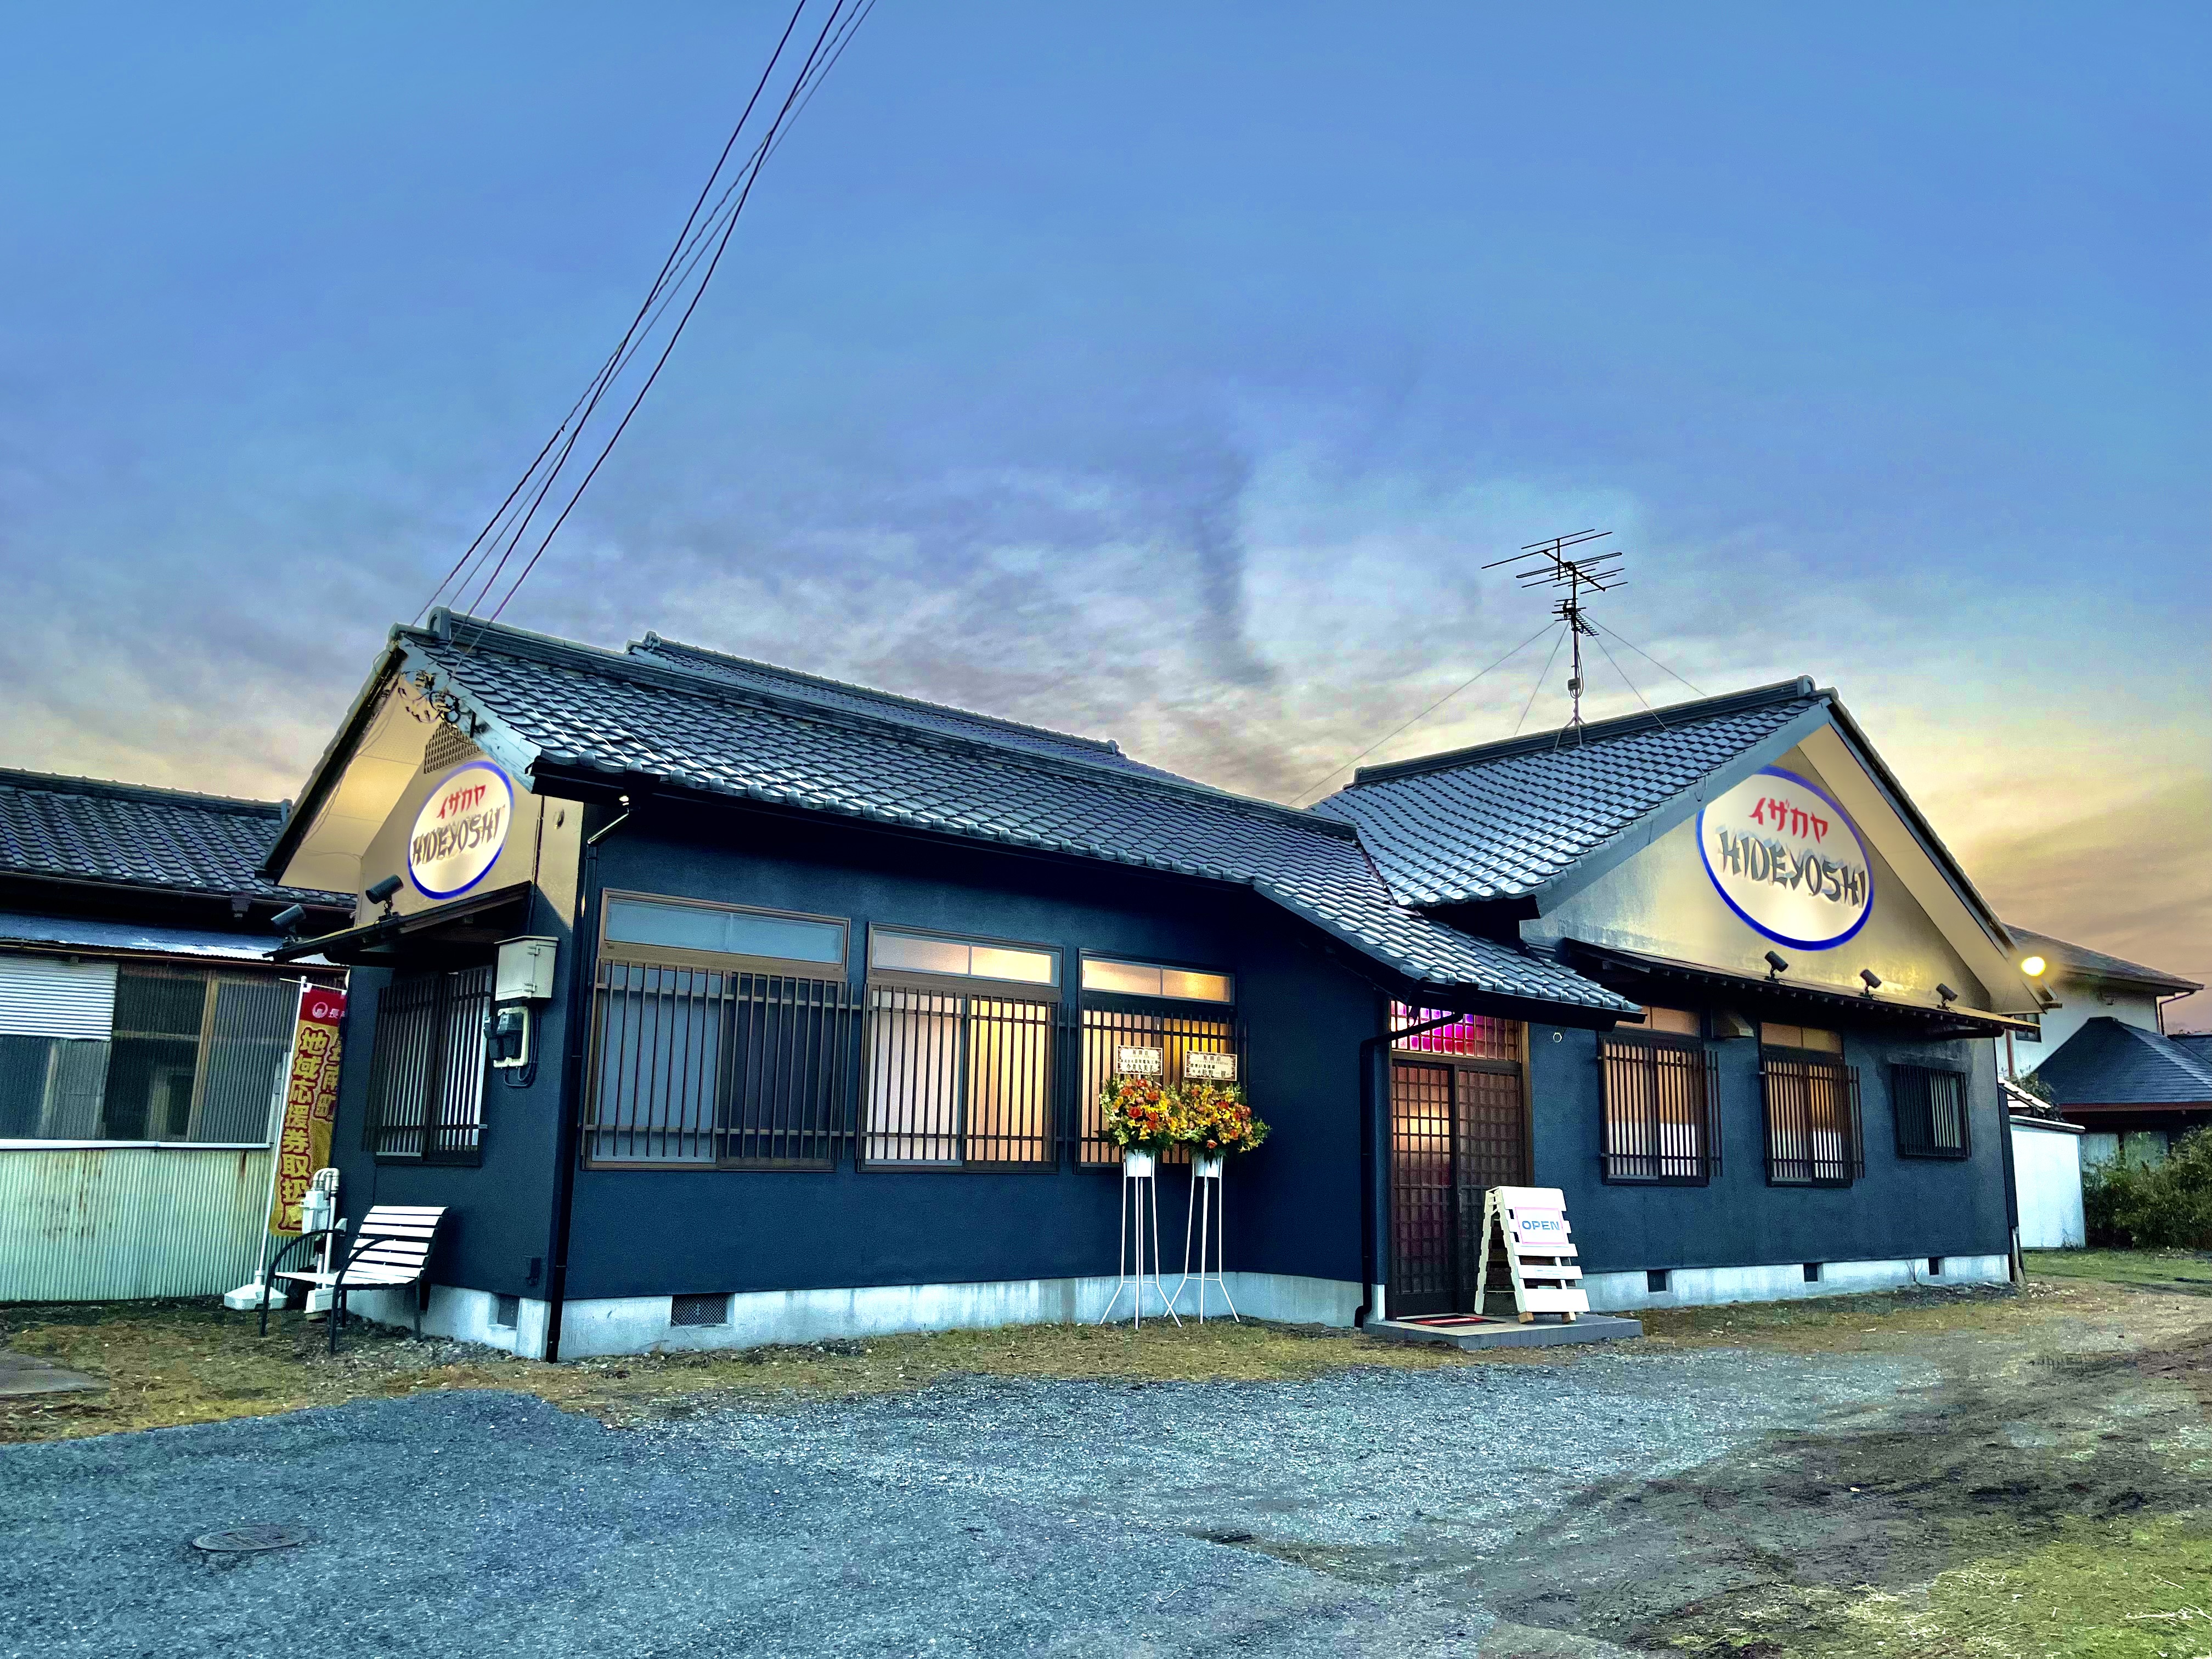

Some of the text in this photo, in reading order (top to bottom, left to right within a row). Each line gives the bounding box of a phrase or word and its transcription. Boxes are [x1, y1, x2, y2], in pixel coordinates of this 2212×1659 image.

[437, 785, 486, 819] イザカヤ
[1748, 798, 1828, 844] イザカヤ
[411, 804, 505, 866] HIDEYOSHI
[1716, 825, 1865, 909] HIDEYOSHI
[1522, 1221, 1560, 1230] OPEN
